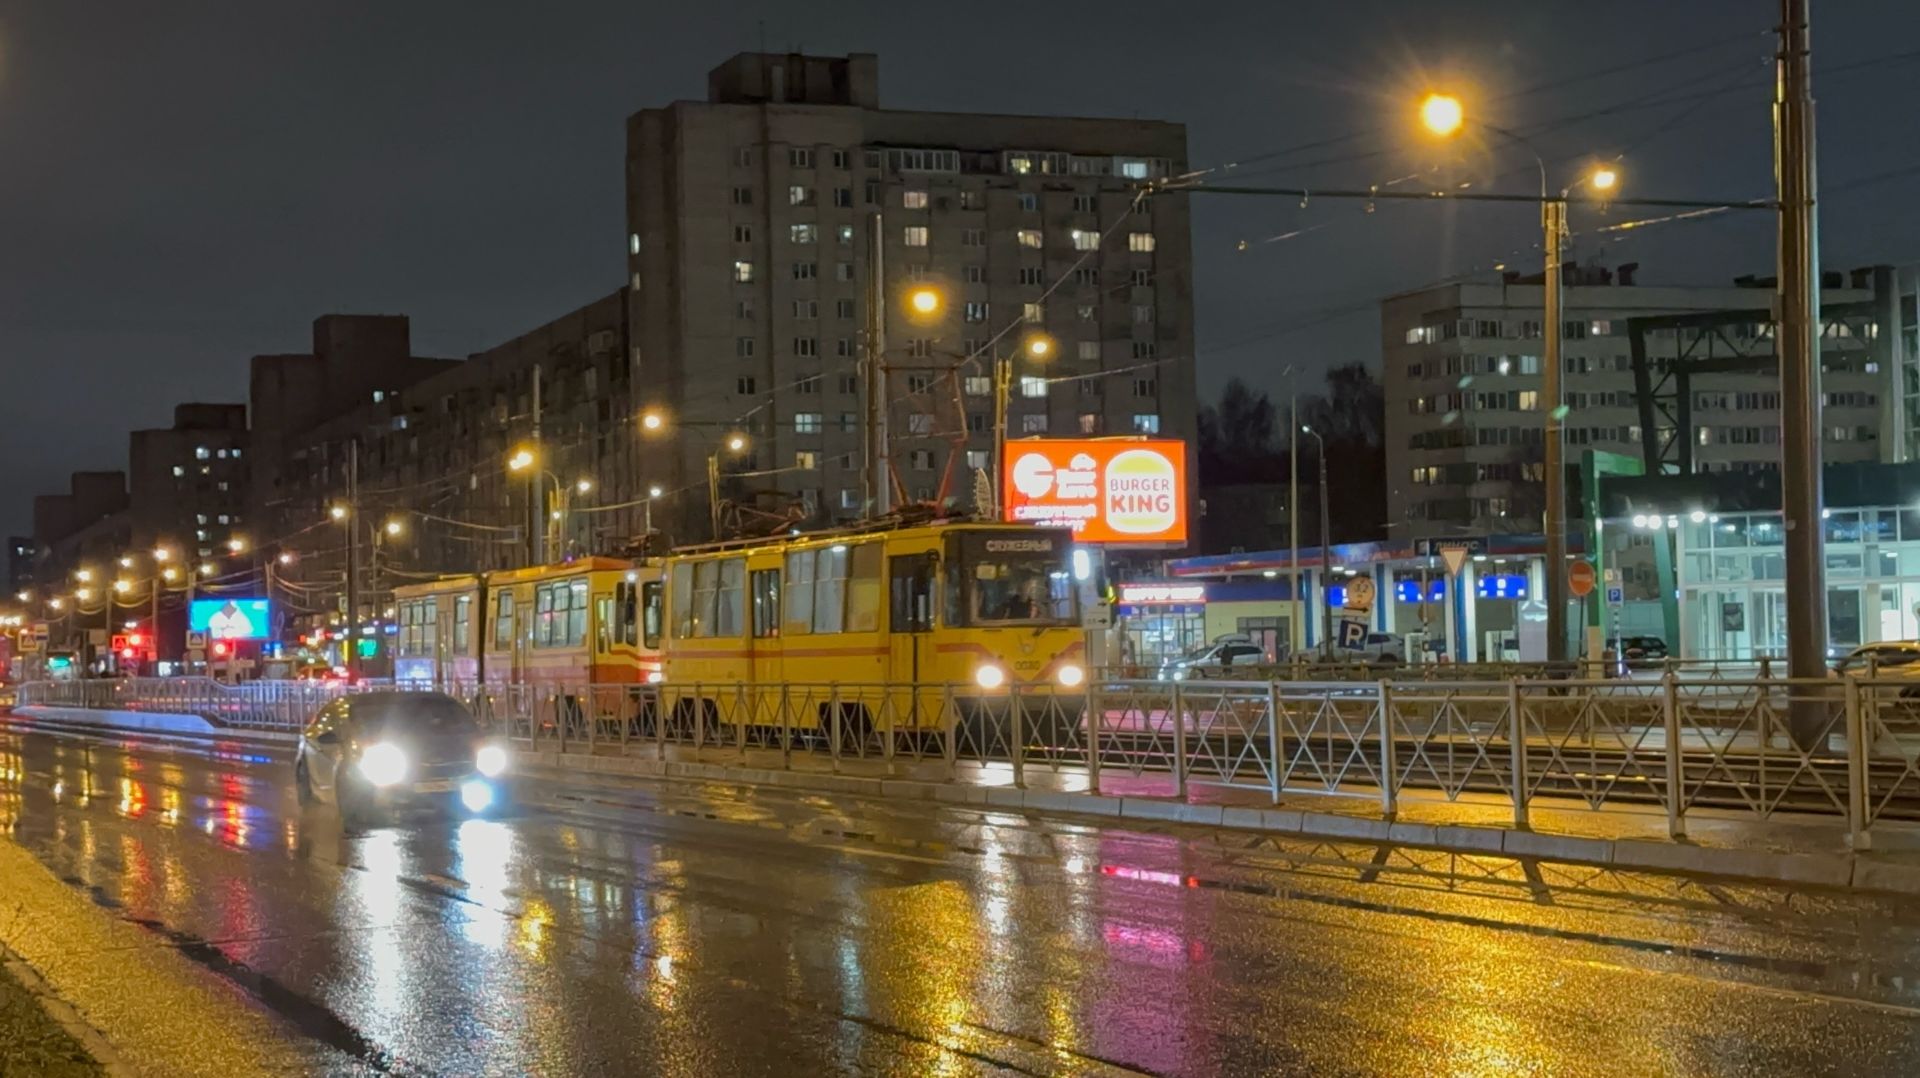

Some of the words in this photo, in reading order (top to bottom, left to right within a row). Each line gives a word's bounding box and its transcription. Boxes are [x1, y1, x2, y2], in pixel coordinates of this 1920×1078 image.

[1110, 478, 1170, 491] BURGER
[1110, 494, 1171, 513] KING
[1610, 589, 1619, 601] P
[1345, 623, 1363, 646] P
